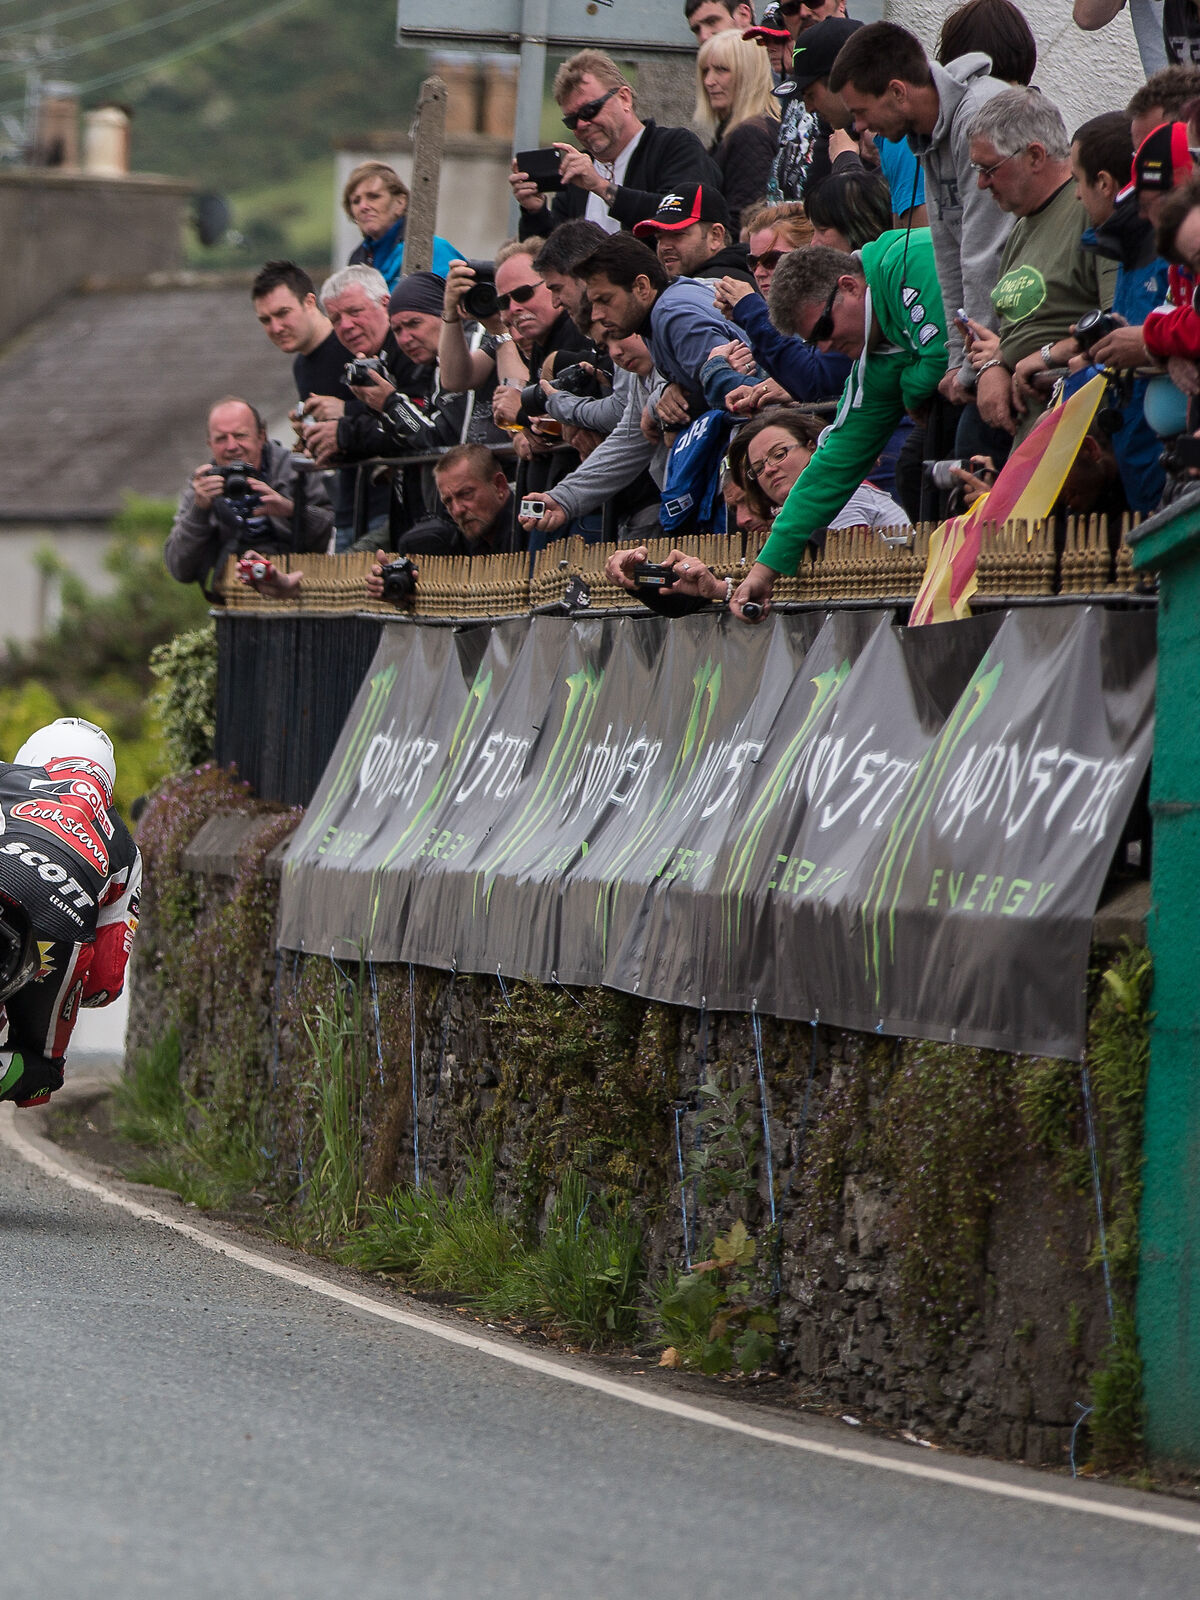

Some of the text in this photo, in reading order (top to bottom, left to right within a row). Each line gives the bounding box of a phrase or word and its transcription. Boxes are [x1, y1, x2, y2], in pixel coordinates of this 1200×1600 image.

[71, 780, 112, 836] Colas
[935, 720, 1136, 842] MONSTER
[15, 802, 108, 873] Cookstown
[49, 894, 85, 927] LEATHERS
[928, 869, 1055, 917] ENERGY
